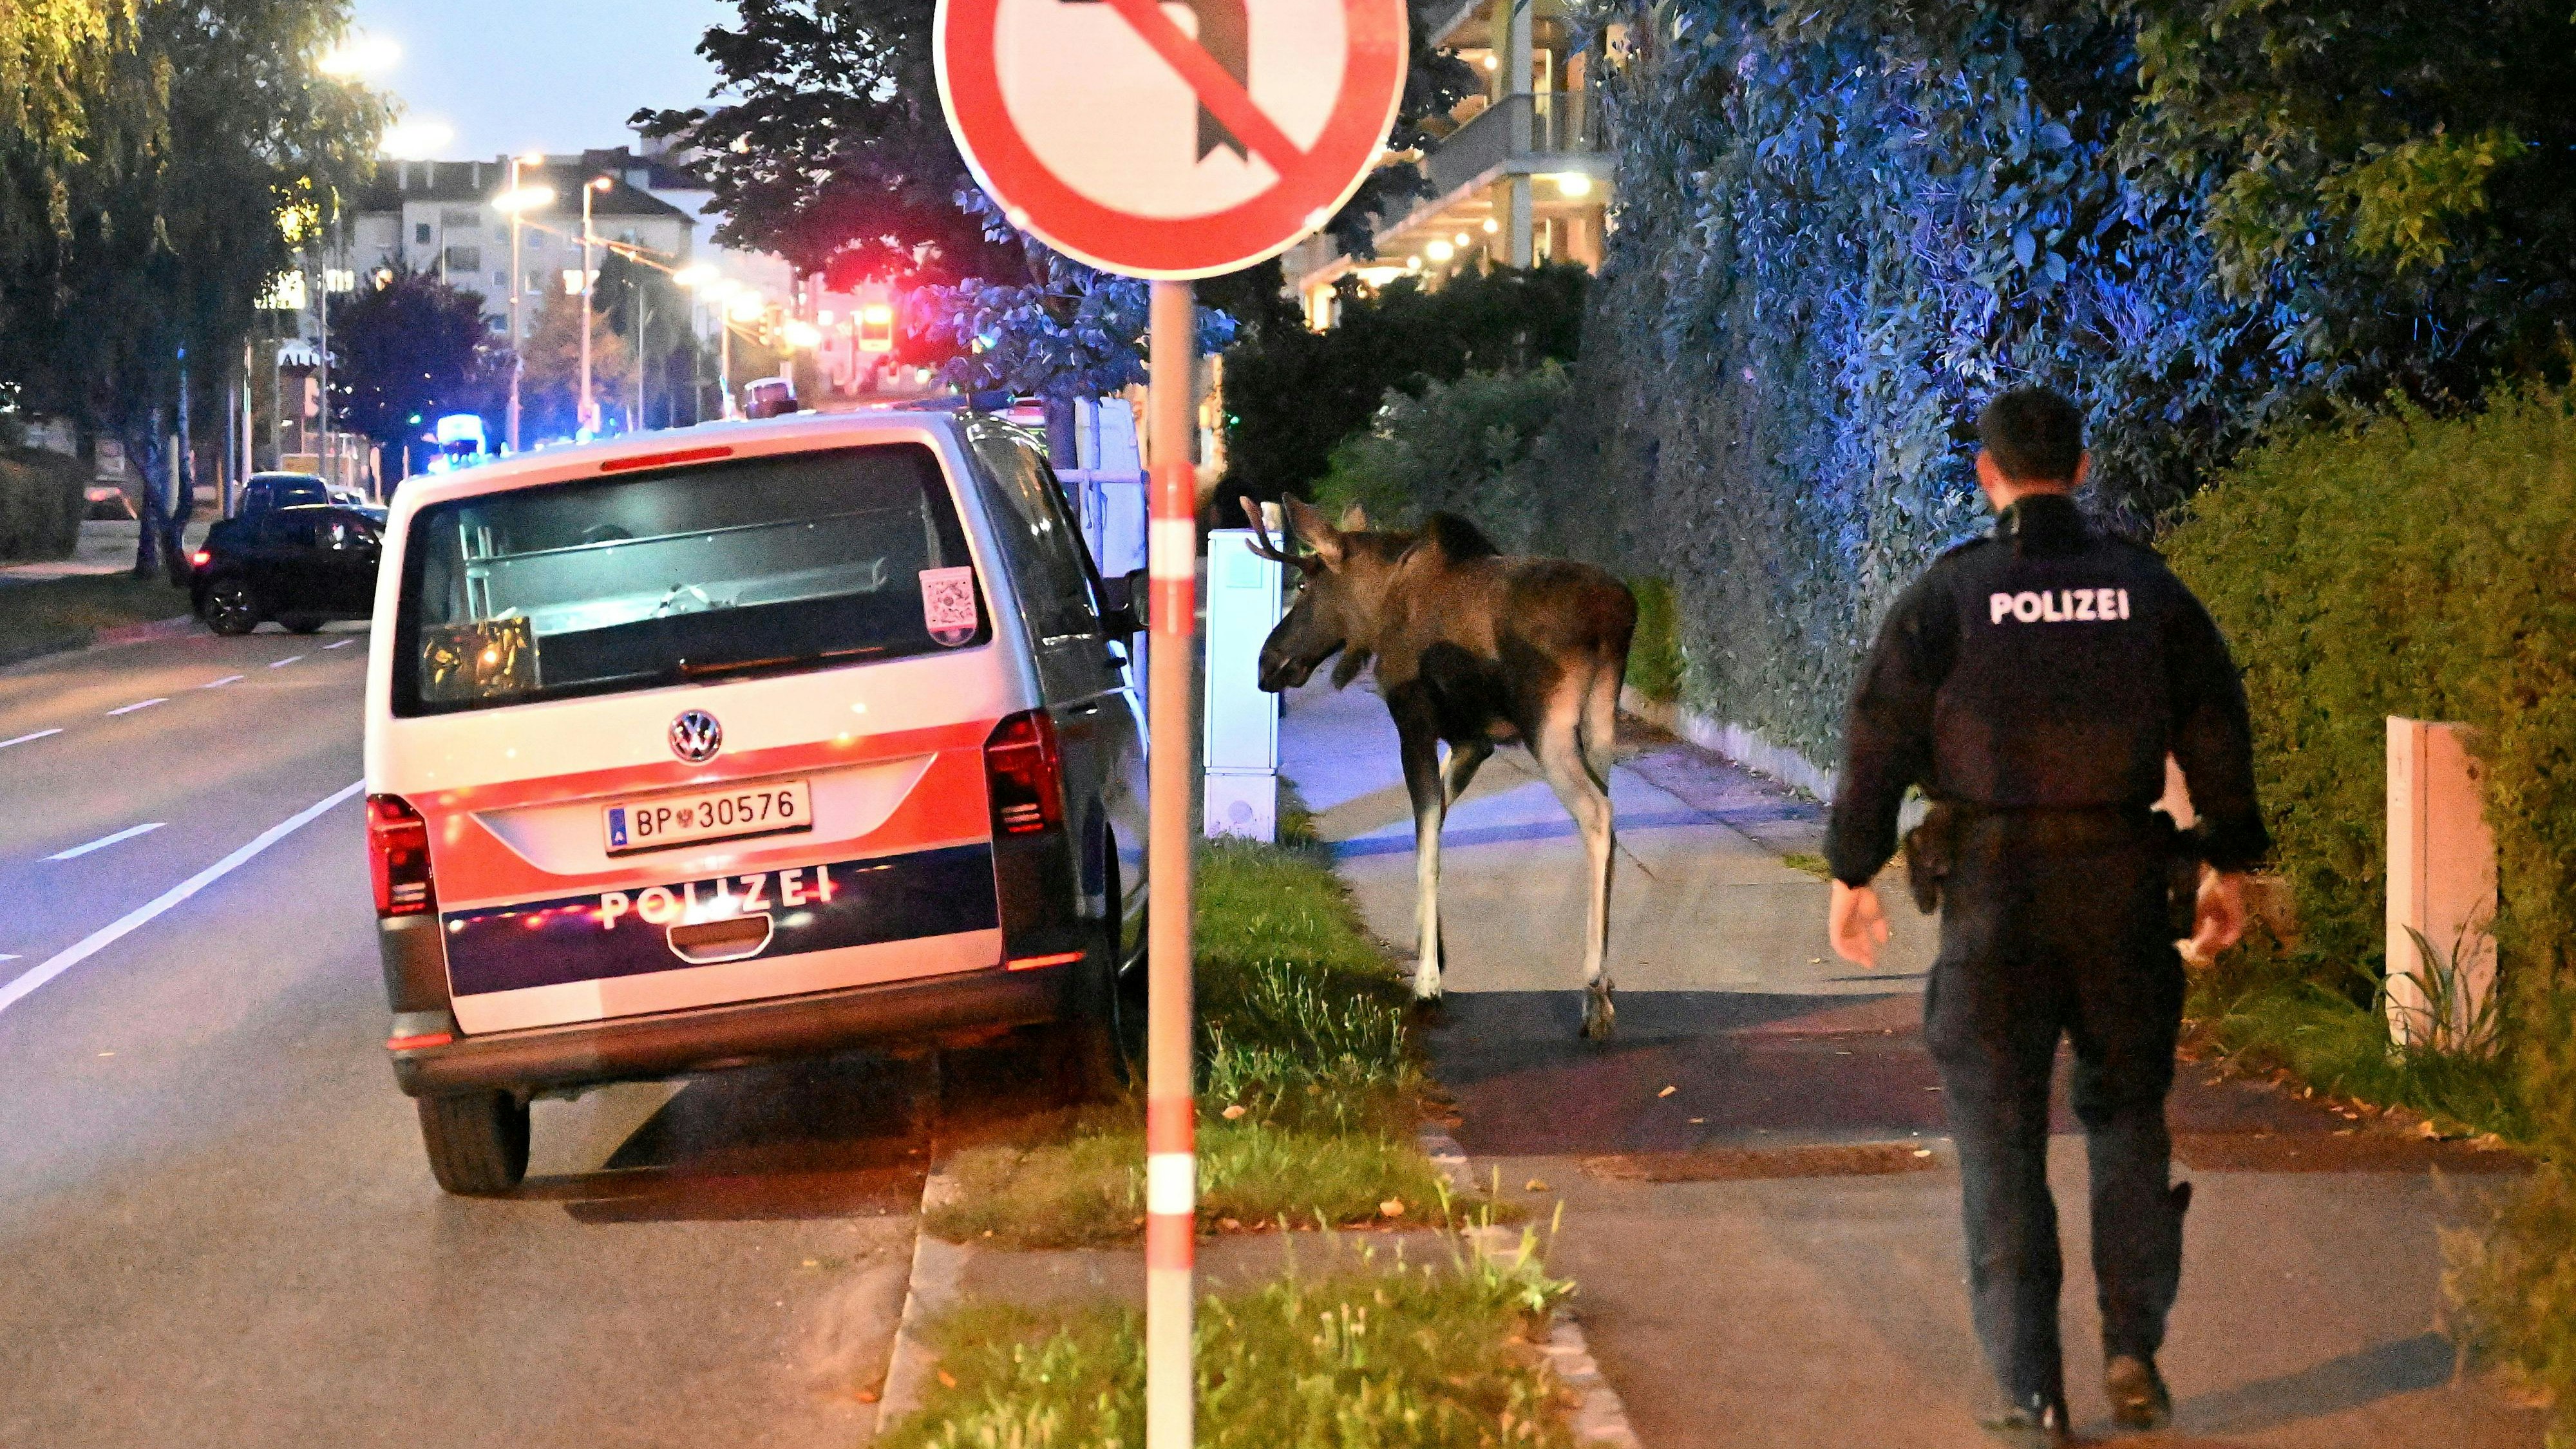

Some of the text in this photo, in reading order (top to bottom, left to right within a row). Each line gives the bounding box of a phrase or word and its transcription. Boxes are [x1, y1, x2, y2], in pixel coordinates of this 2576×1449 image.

[1990, 588, 2130, 625] POLIZEI
[637, 791, 794, 836] BP 30576
[601, 866, 831, 930] POLIZEI
